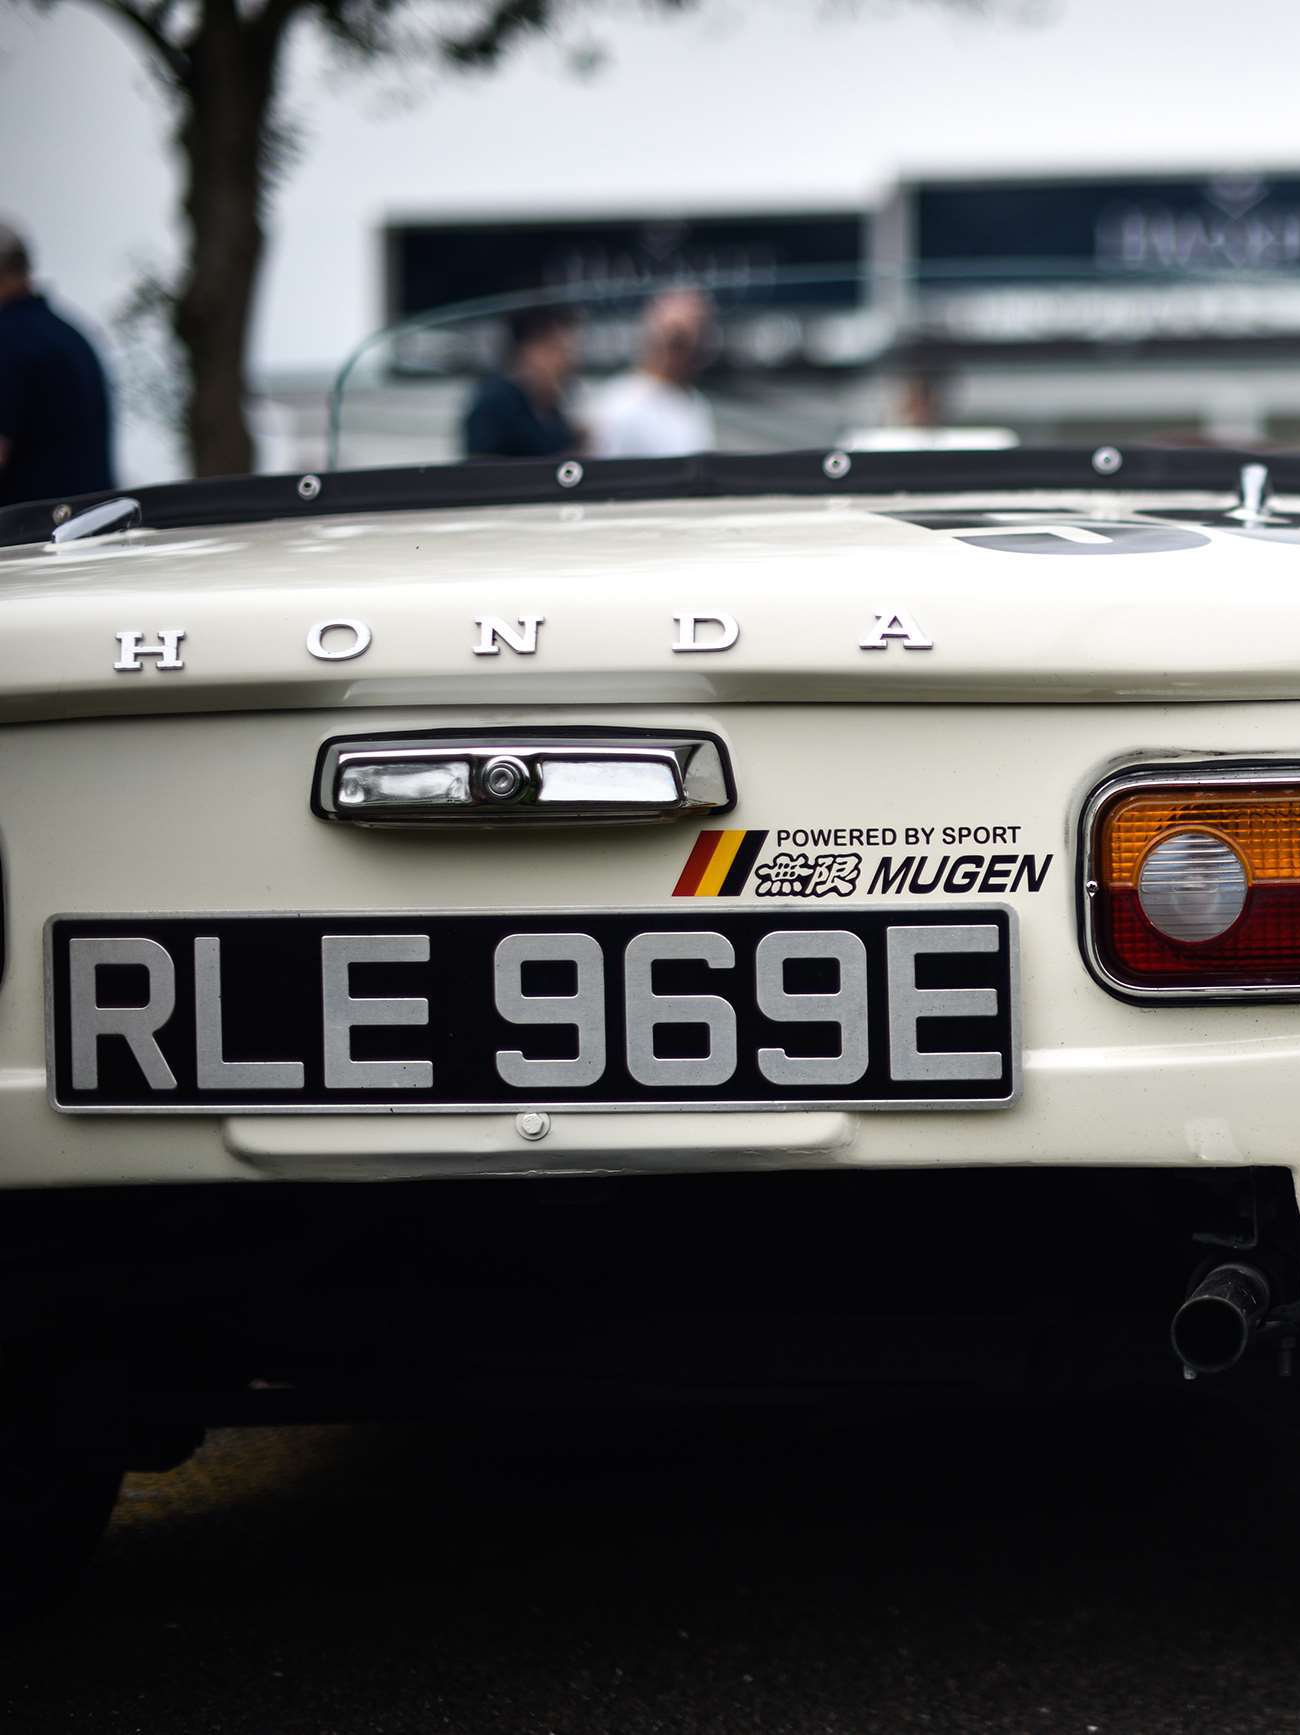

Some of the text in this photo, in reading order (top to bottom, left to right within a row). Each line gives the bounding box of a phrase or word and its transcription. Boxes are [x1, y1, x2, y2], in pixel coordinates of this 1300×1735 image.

[113, 607, 934, 671] HONDA
[777, 826, 1022, 847] POWERED BY SPORT
[754, 852, 862, 897] 無限
[867, 854, 1053, 895] MUGEN
[69, 924, 1003, 1091] RLE 969E
